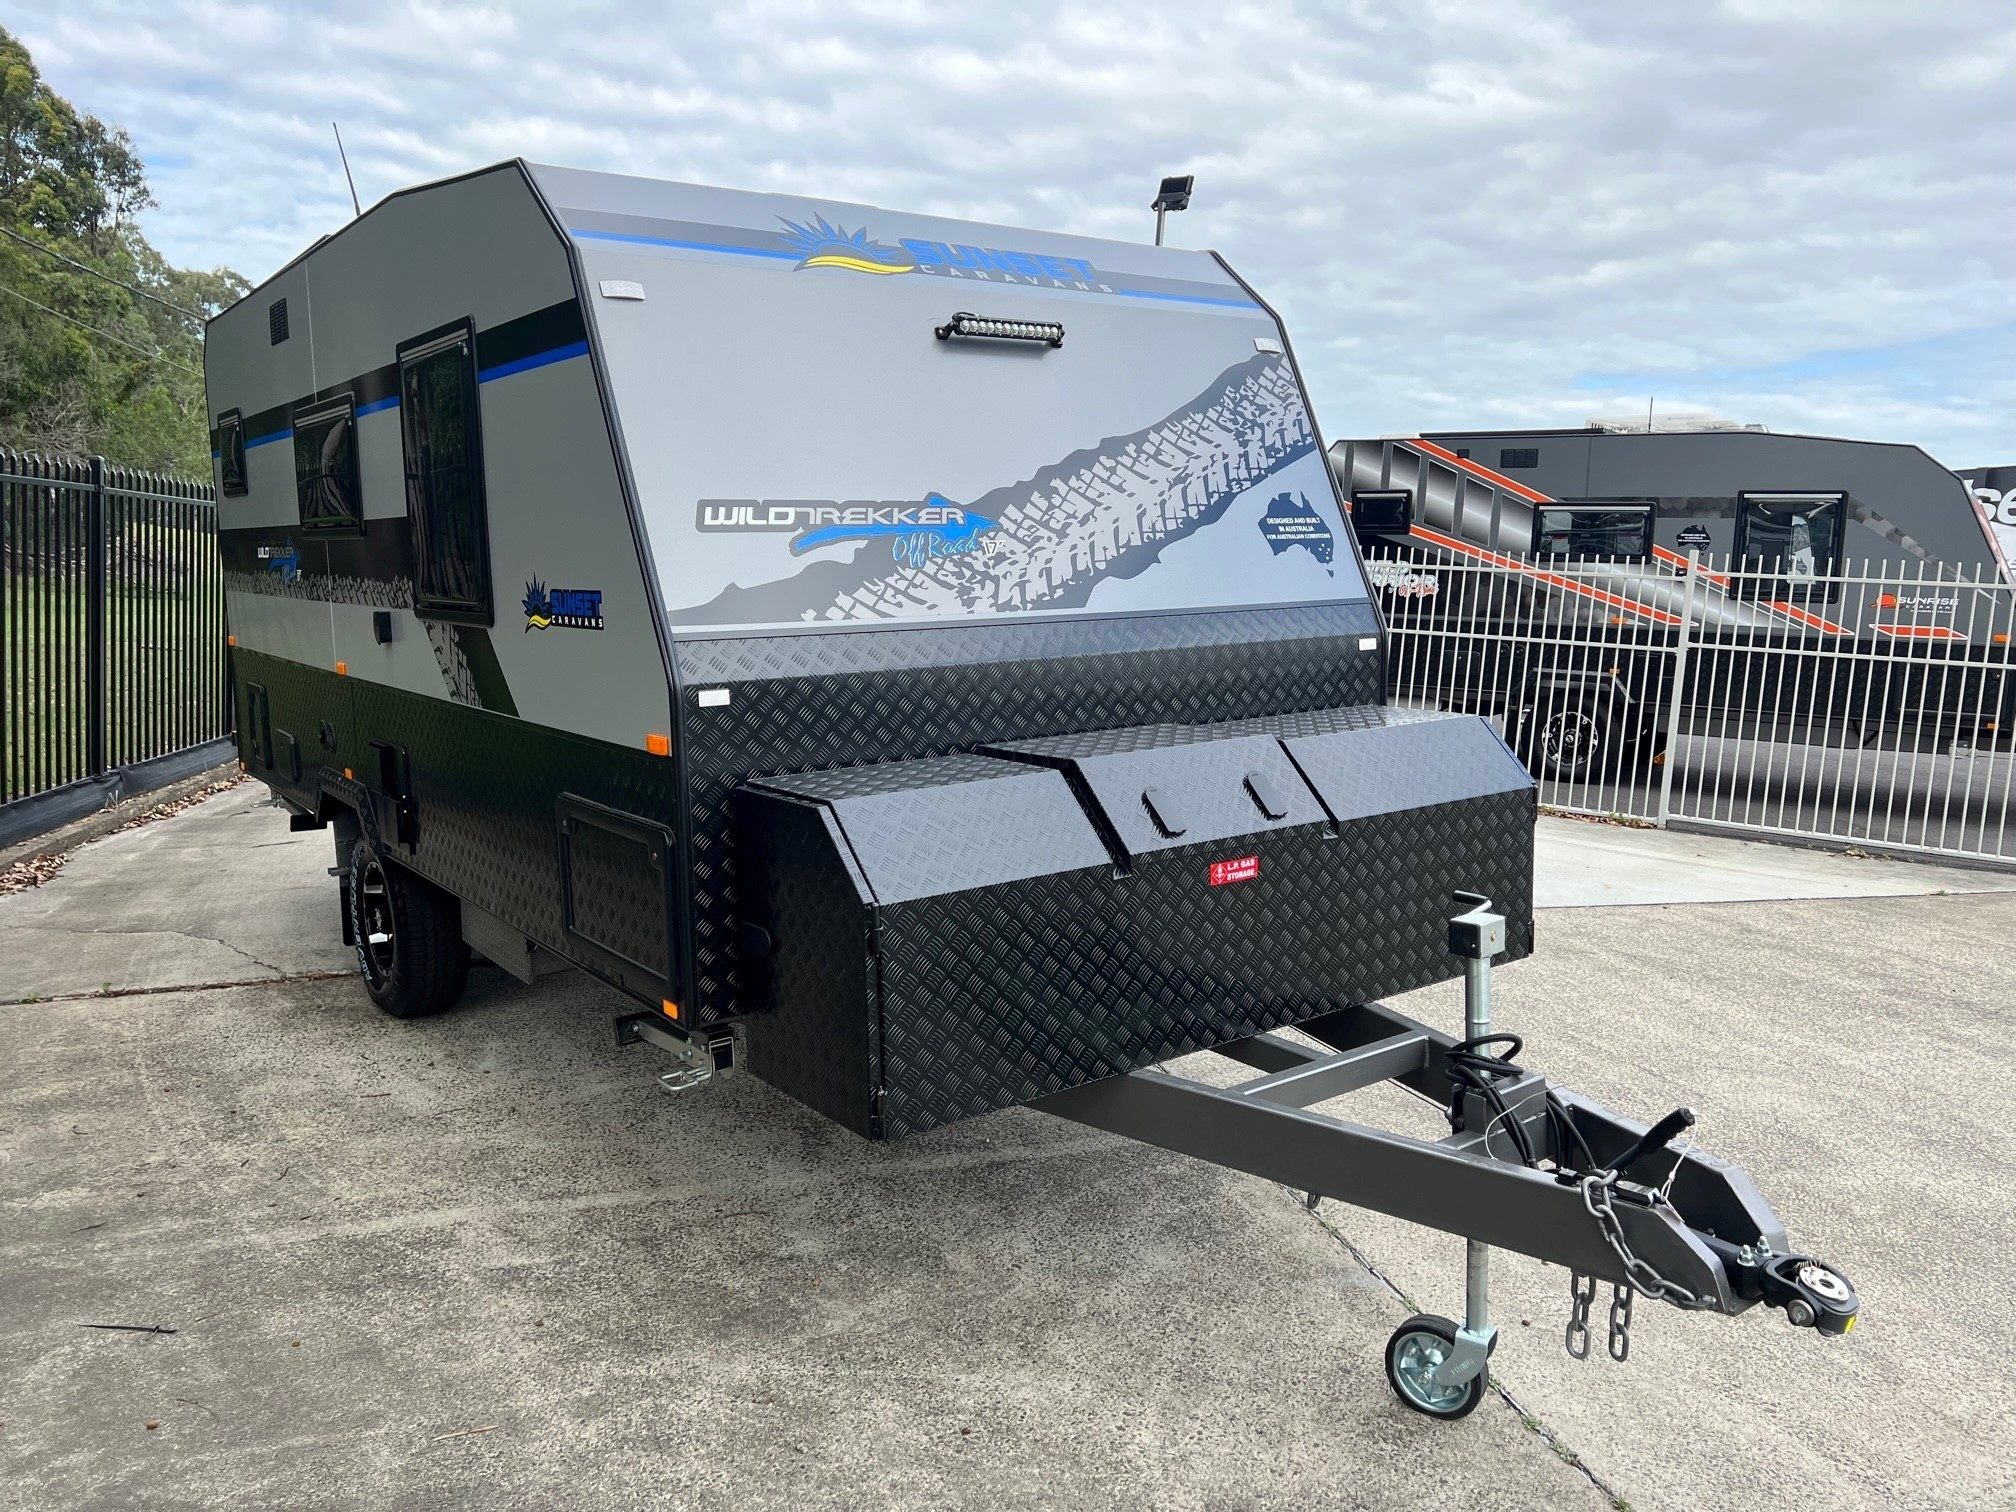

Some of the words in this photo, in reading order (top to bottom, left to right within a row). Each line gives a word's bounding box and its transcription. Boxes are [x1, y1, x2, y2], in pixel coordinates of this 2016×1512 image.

[901, 239, 1096, 281] SUNSET
[920, 265, 1113, 293] CARAVANS
[704, 506, 966, 525] WILDTREKKER
[893, 532, 925, 568] Off
[928, 528, 978, 557] Road
[550, 590, 602, 616] SUNSET
[551, 615, 603, 628] CARAVANS
[1226, 869, 1255, 880] STORAGE
[1240, 859, 1255, 868] GAS
